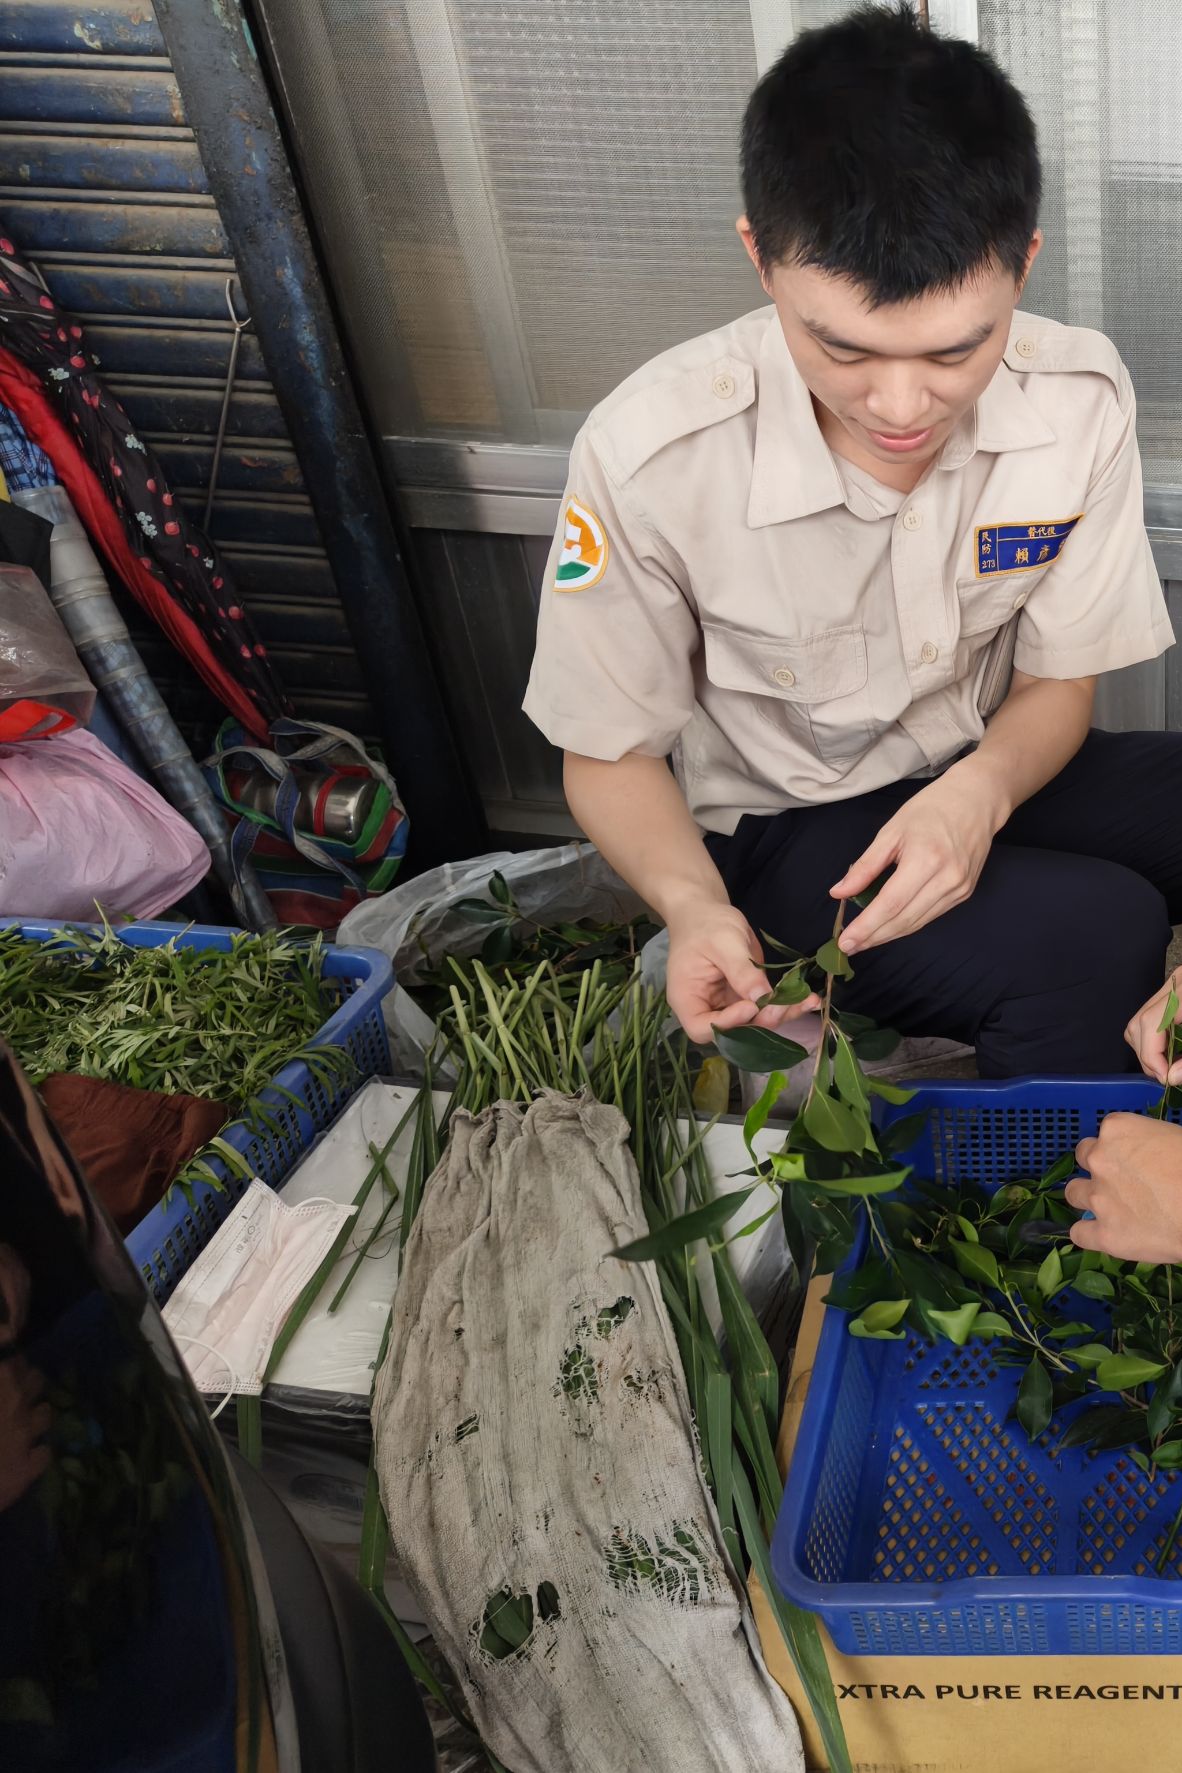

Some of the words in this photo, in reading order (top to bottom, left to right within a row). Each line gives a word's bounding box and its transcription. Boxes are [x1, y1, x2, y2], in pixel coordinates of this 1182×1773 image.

[1027, 526, 1057, 538] 替代役
[833, 1684, 926, 1700] XTRA
[935, 1684, 1022, 1700] PURE
